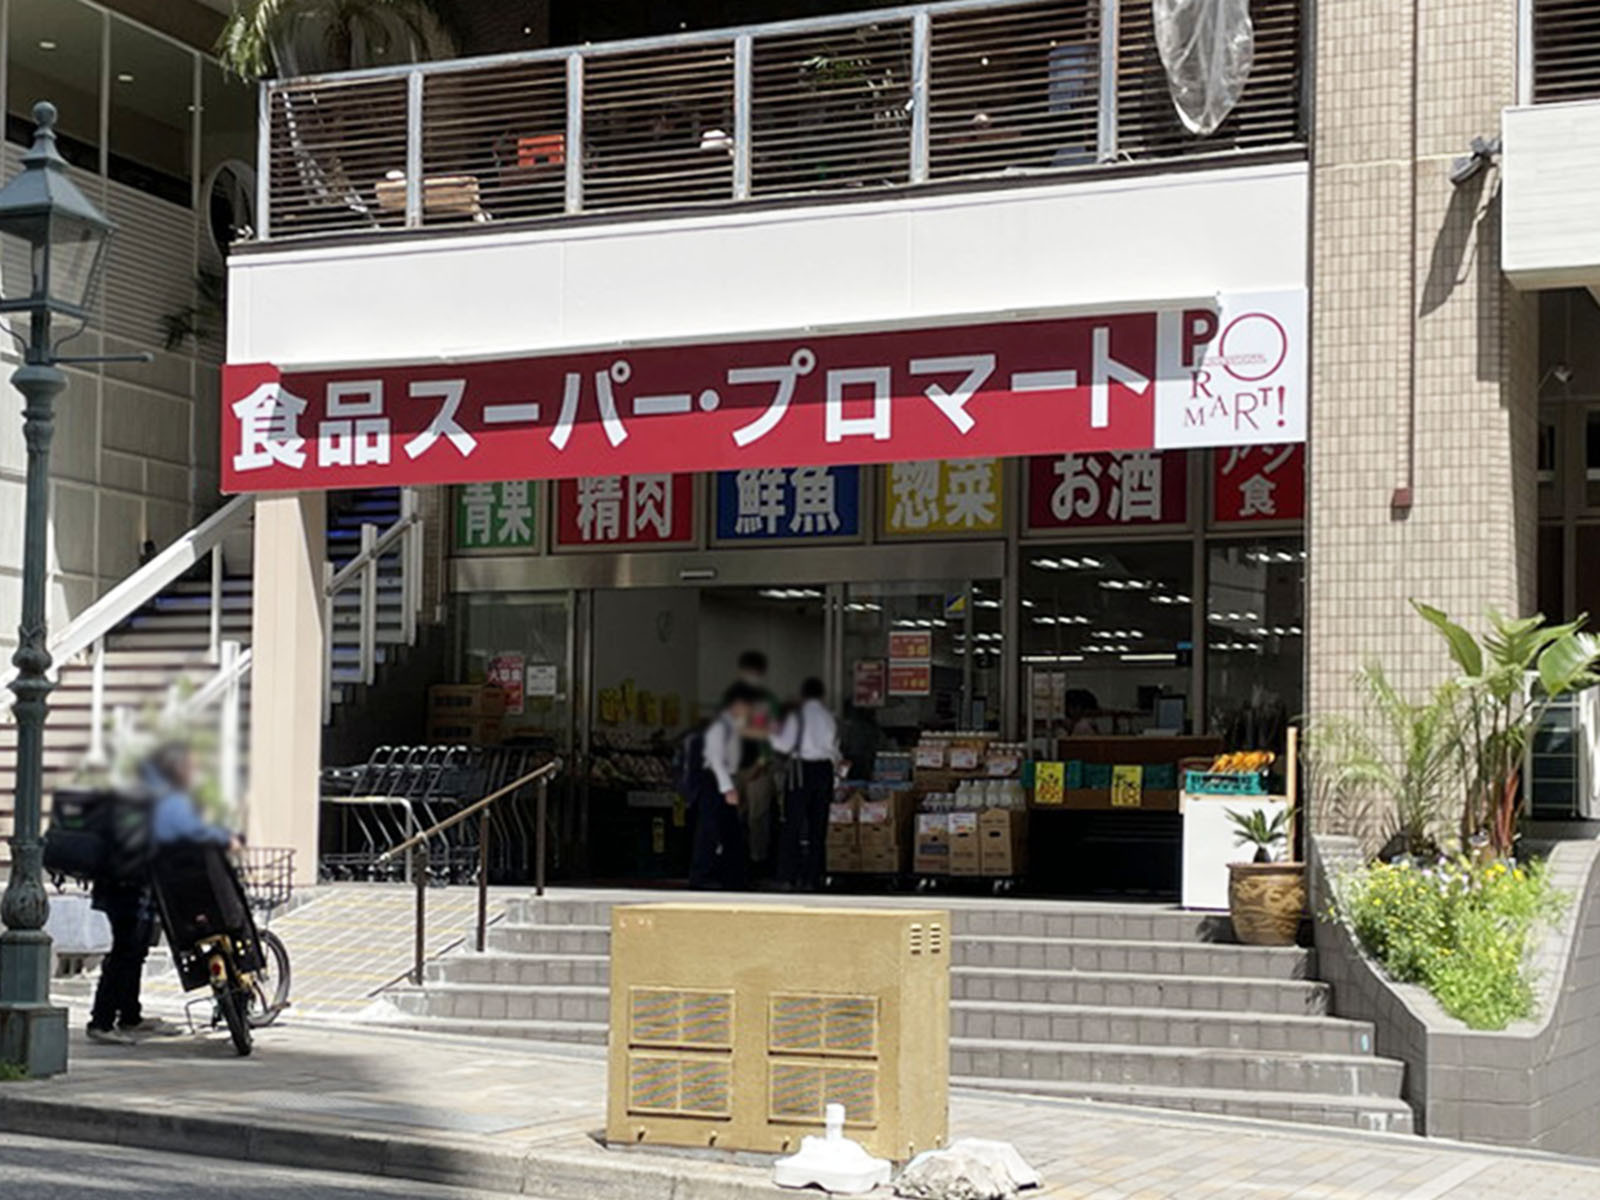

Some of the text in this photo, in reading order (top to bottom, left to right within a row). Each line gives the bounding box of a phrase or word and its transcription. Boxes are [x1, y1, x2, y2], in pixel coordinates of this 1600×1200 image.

[231, 326, 1149, 474] 食品スーパー・プロマート
[1184, 385, 1287, 432] MART!
[461, 481, 533, 546] 青果
[576, 473, 673, 541] 精肉
[734, 466, 841, 535] 鮮魚
[891, 461, 997, 529] 惣菜
[1051, 450, 1163, 522] お酒
[1237, 472, 1278, 517] 食
